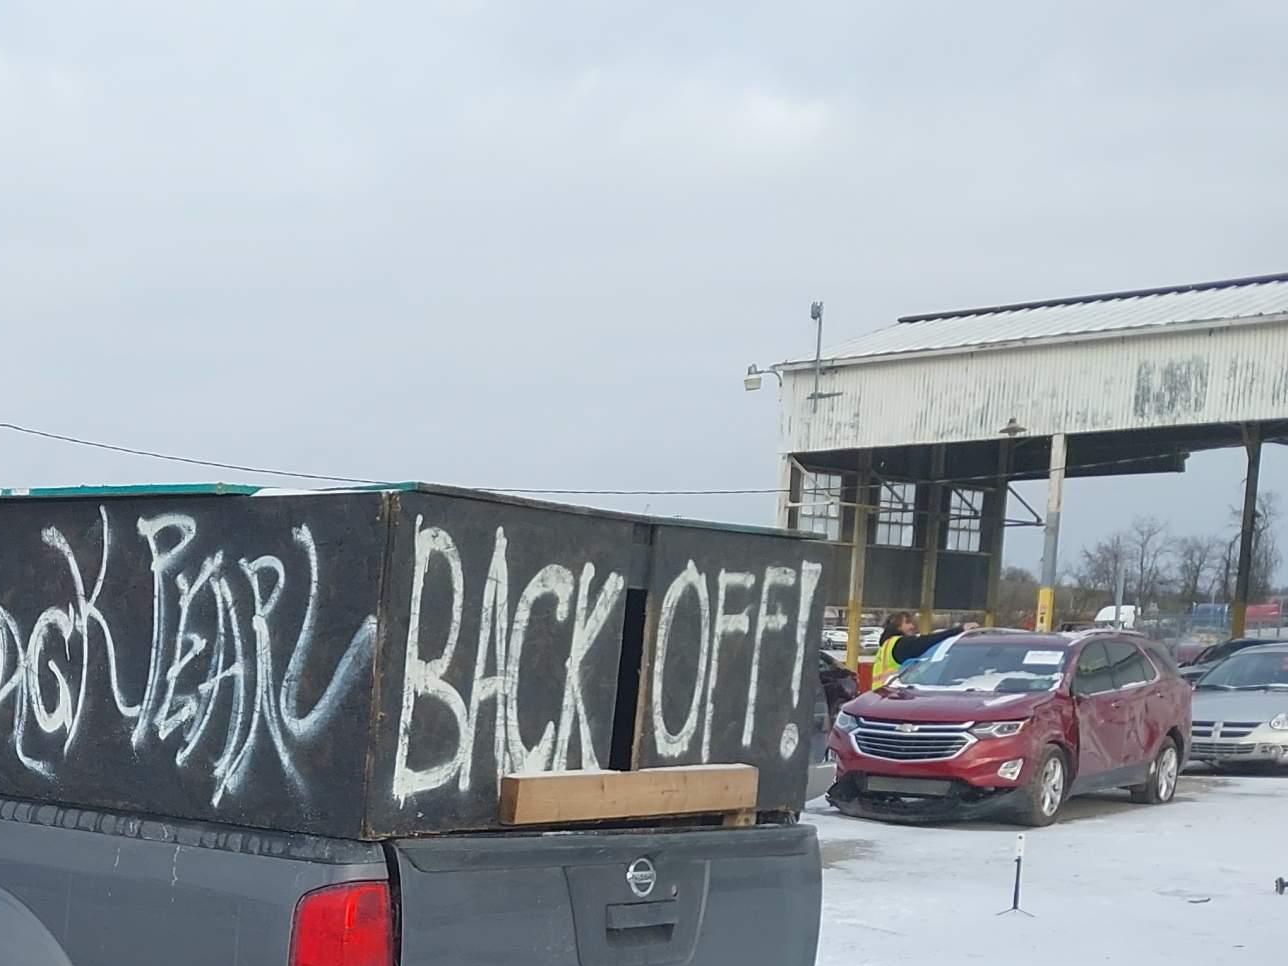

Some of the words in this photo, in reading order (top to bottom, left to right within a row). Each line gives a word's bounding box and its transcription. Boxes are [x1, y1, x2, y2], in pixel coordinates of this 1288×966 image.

[131, 513, 379, 810] PEARL
[393, 513, 625, 808] BACK
[652, 558, 824, 764] OFF!
